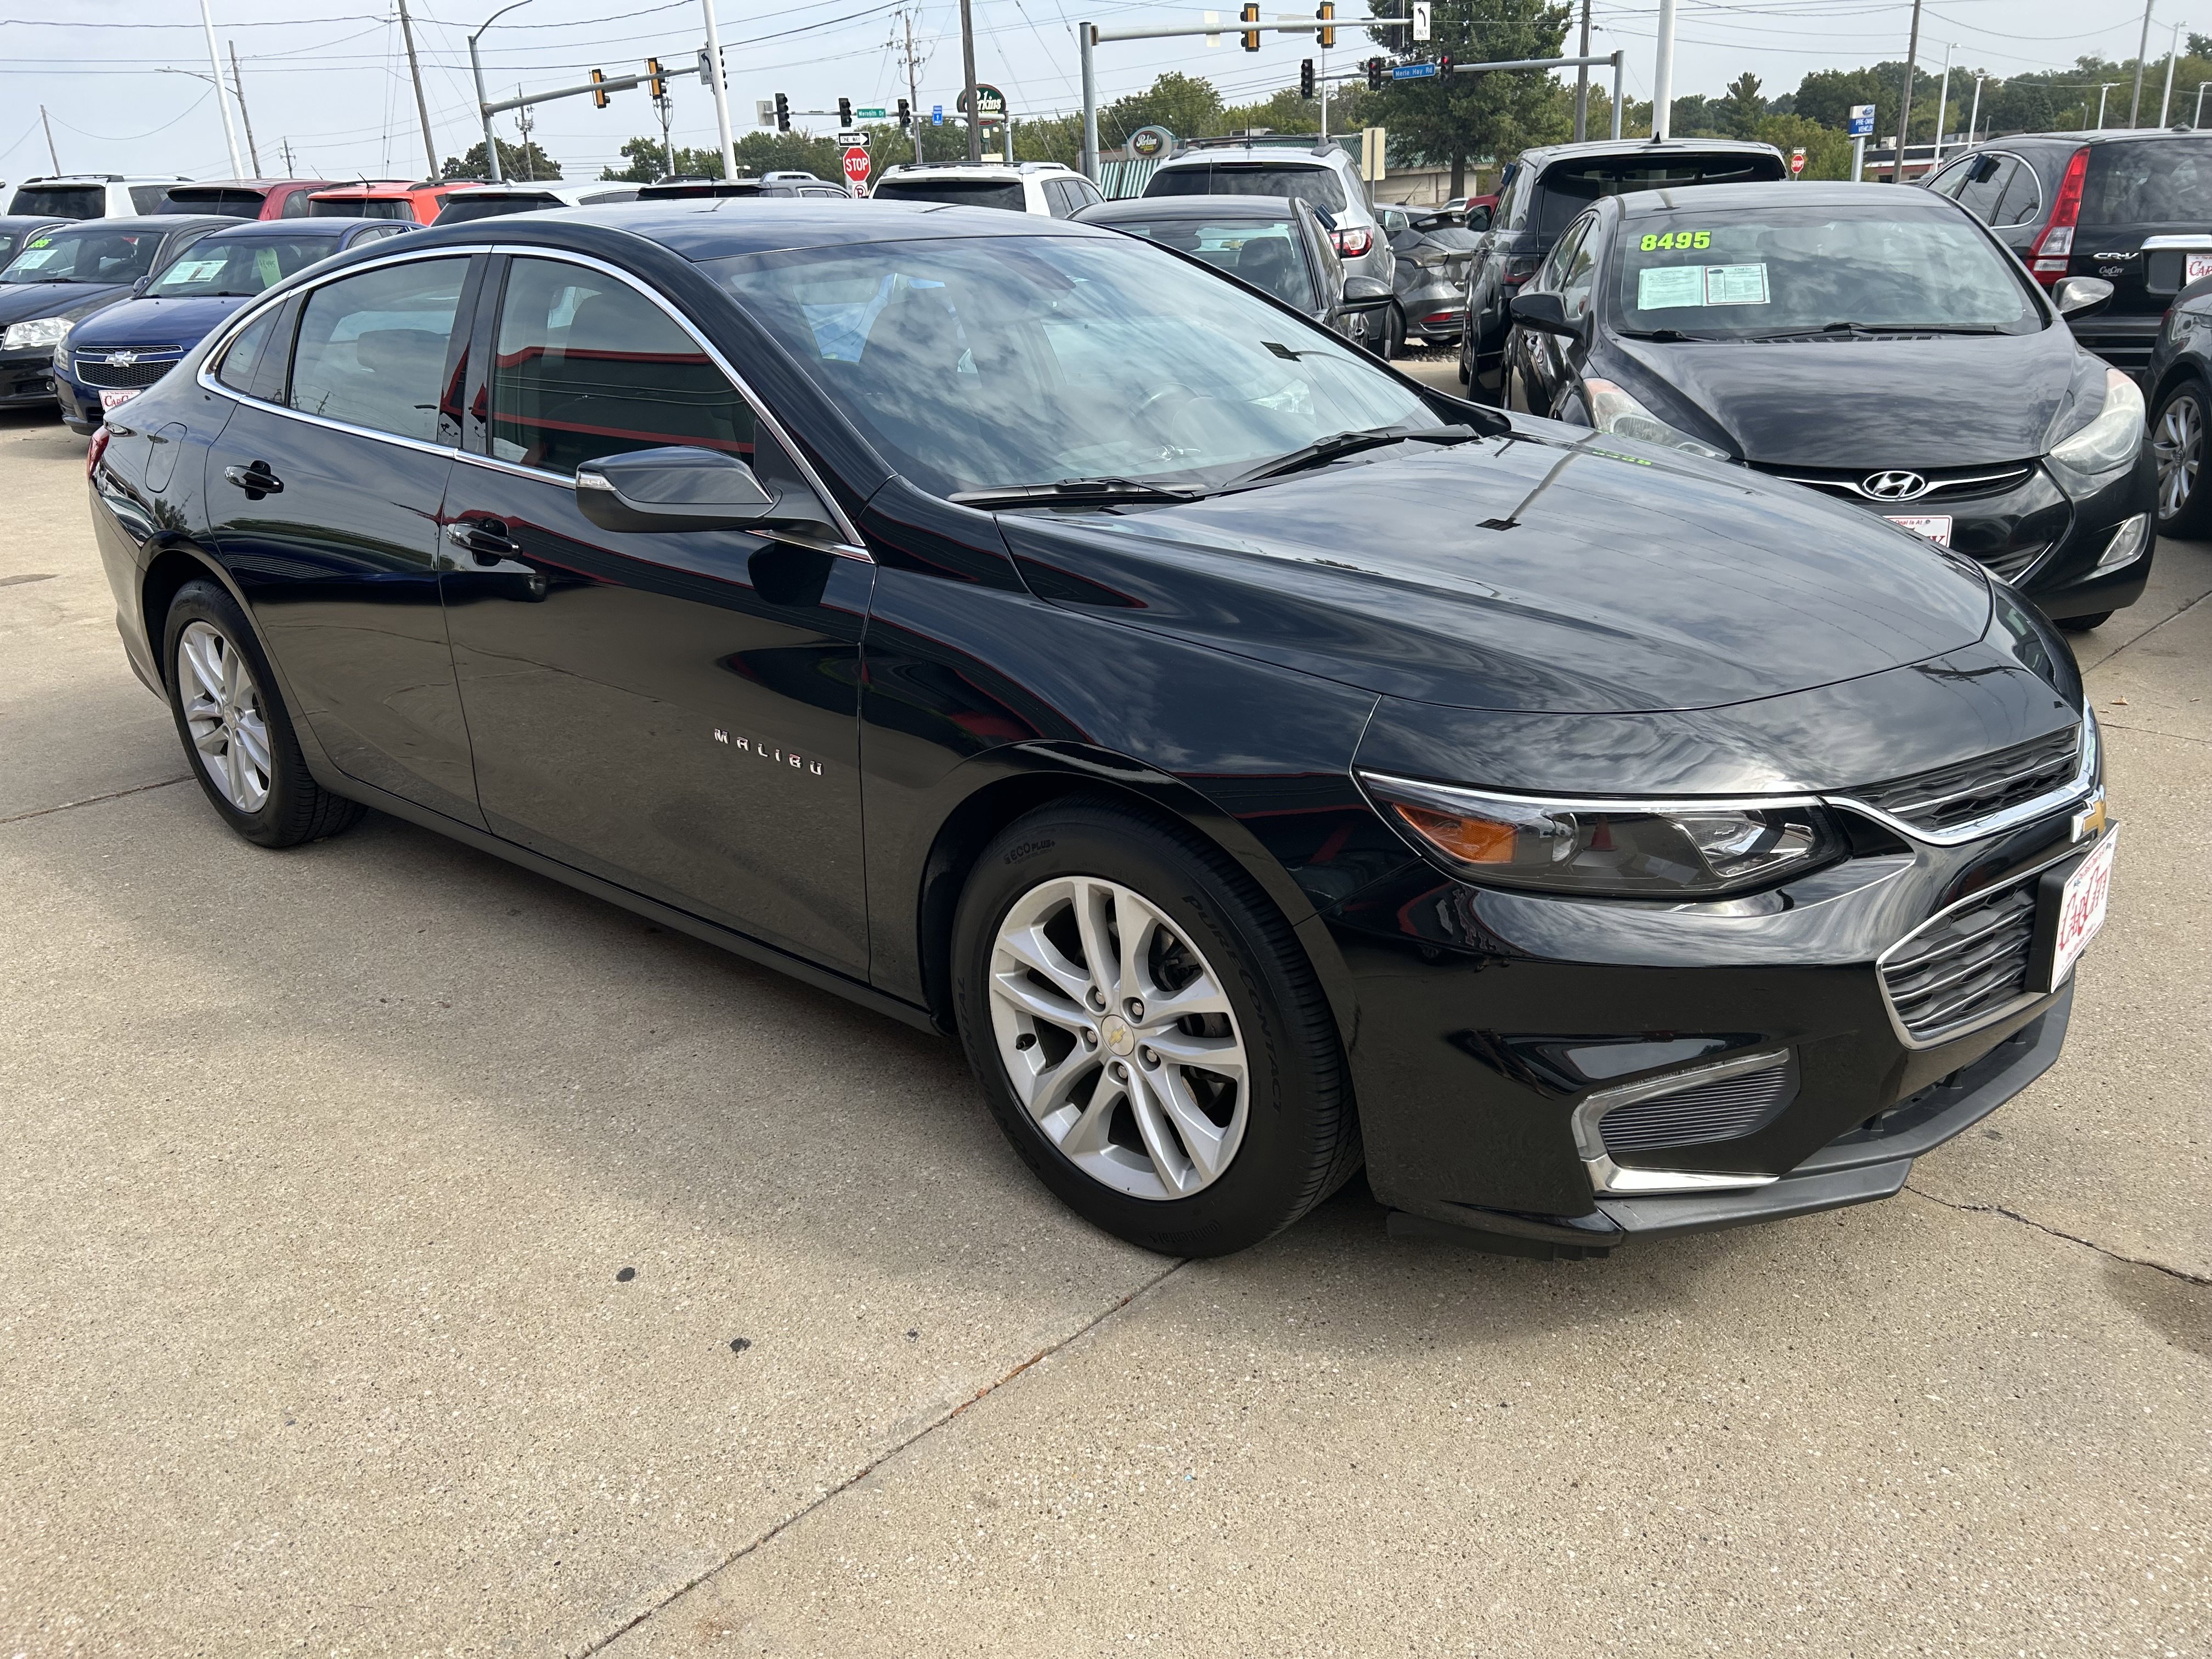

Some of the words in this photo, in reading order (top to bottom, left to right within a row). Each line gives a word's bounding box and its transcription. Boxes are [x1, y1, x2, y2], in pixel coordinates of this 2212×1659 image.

[964, 90, 1002, 111] rkins
[845, 157, 868, 172] STOP
[1640, 230, 1712, 252] 8495
[2093, 252, 2139, 261] CR-V
[713, 727, 825, 776] MALIBU
